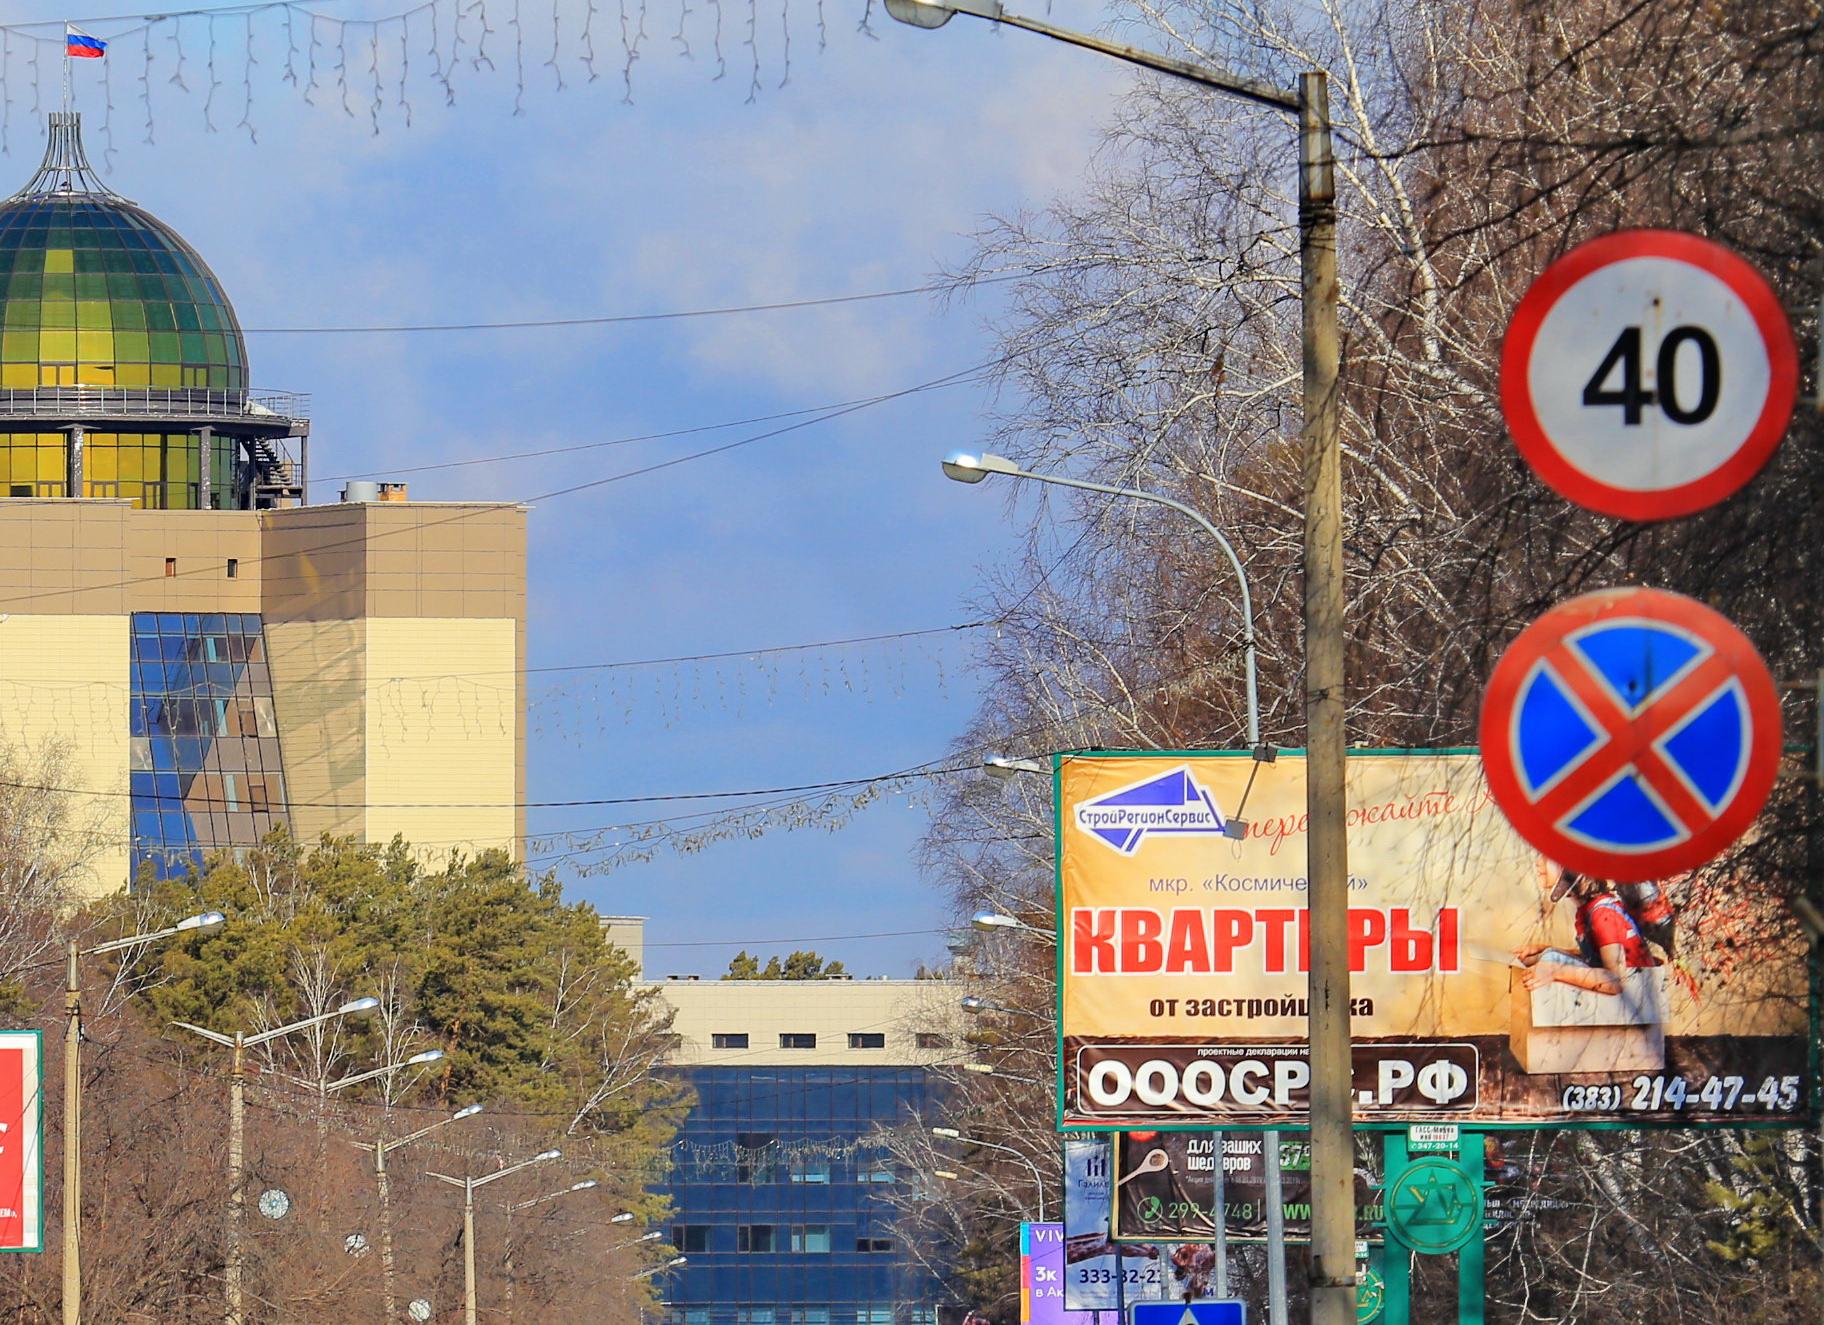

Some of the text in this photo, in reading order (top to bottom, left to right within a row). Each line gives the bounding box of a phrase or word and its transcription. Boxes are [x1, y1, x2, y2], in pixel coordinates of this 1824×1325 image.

[1582, 325, 1721, 426] 40
[1079, 808, 1211, 827] СтройРегионСервис
[1243, 791, 1459, 857] пережайте
[1149, 873, 1368, 896] мкр. «Космичей»
[1150, 993, 1374, 1019] от застройка
[1197, 1048, 1244, 1057] проектные
[1245, 1048, 1298, 1058] декларации
[1087, 1059, 1468, 1107] ОООСР.РФ
[1562, 1074, 1800, 1113] (383) 214-47-45
[1187, 1156, 1252, 1175] шедвров
[1035, 1266, 1057, 1282] 3к
